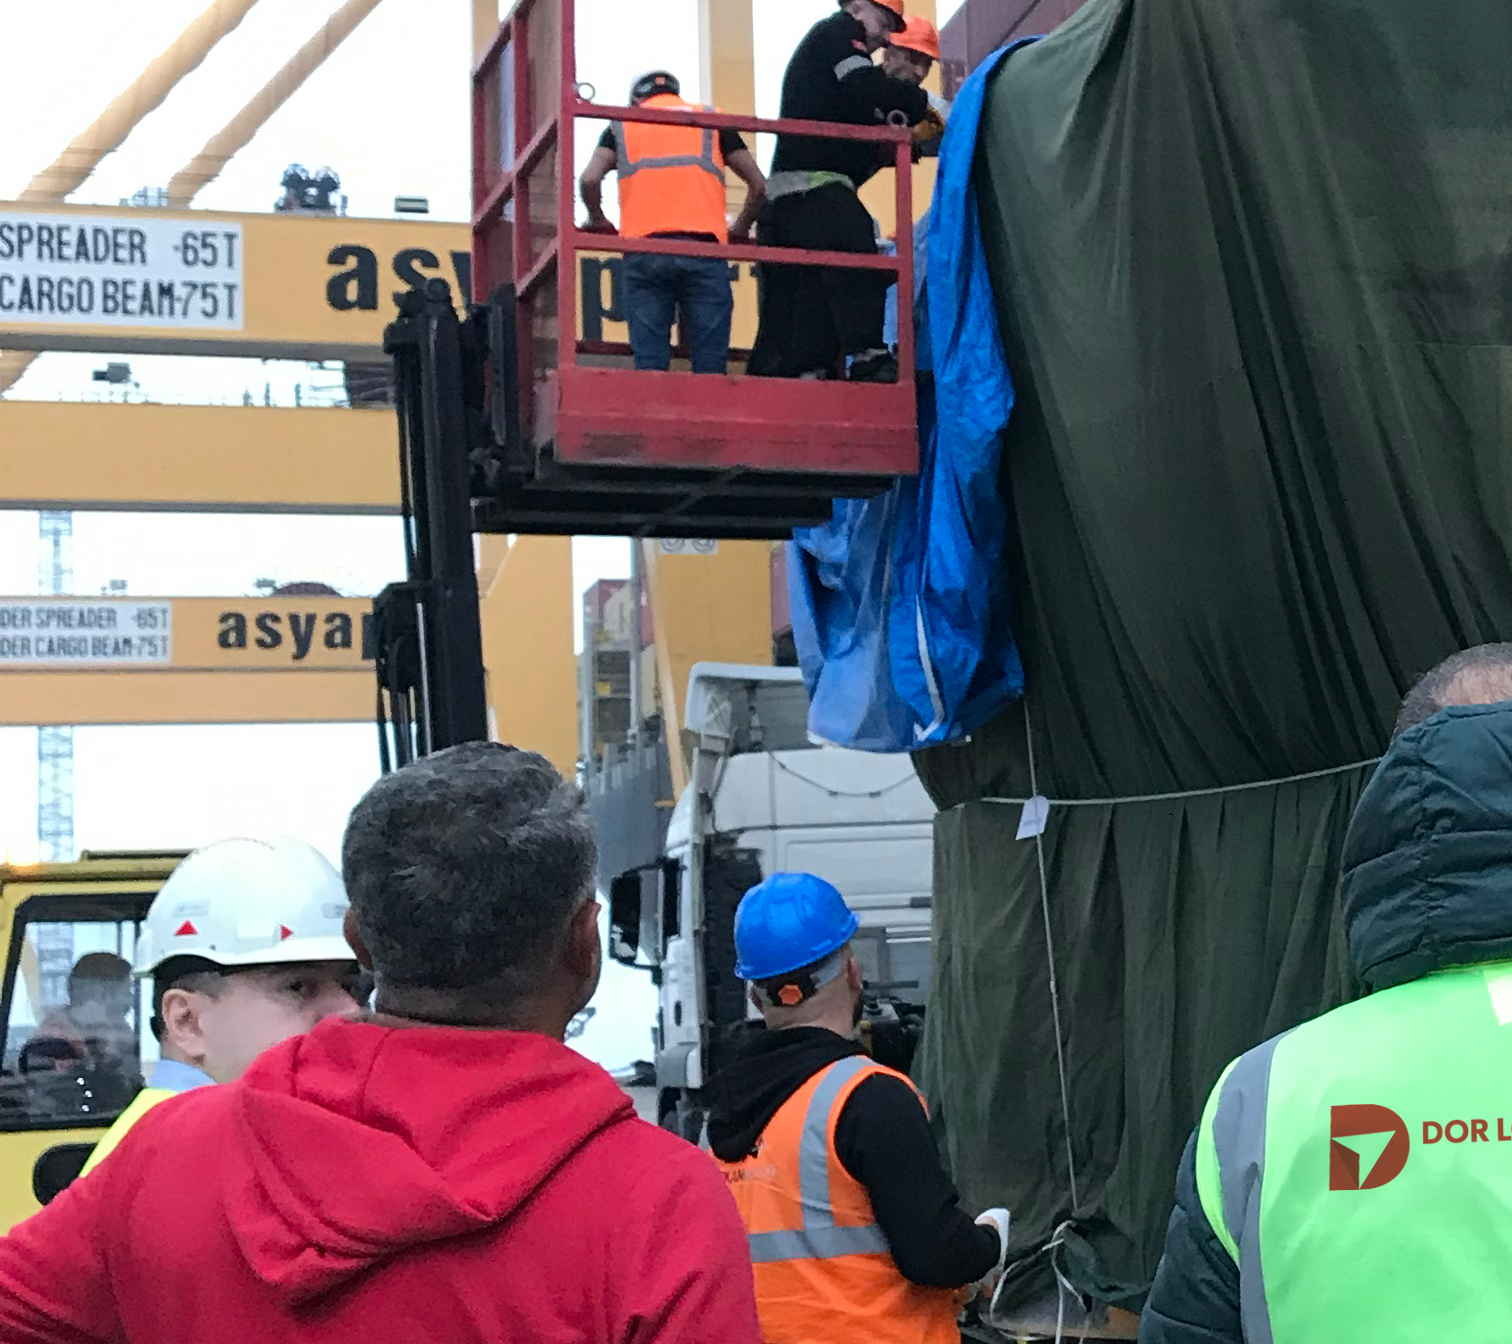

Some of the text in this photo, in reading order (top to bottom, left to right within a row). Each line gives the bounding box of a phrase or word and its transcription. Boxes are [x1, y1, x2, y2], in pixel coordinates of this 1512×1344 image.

[0, 221, 147, 266] SPREADER
[0, 273, 96, 314] CARGO
[36, 607, 118, 630] SPREADER
[1422, 1119, 1490, 1144] DOR
